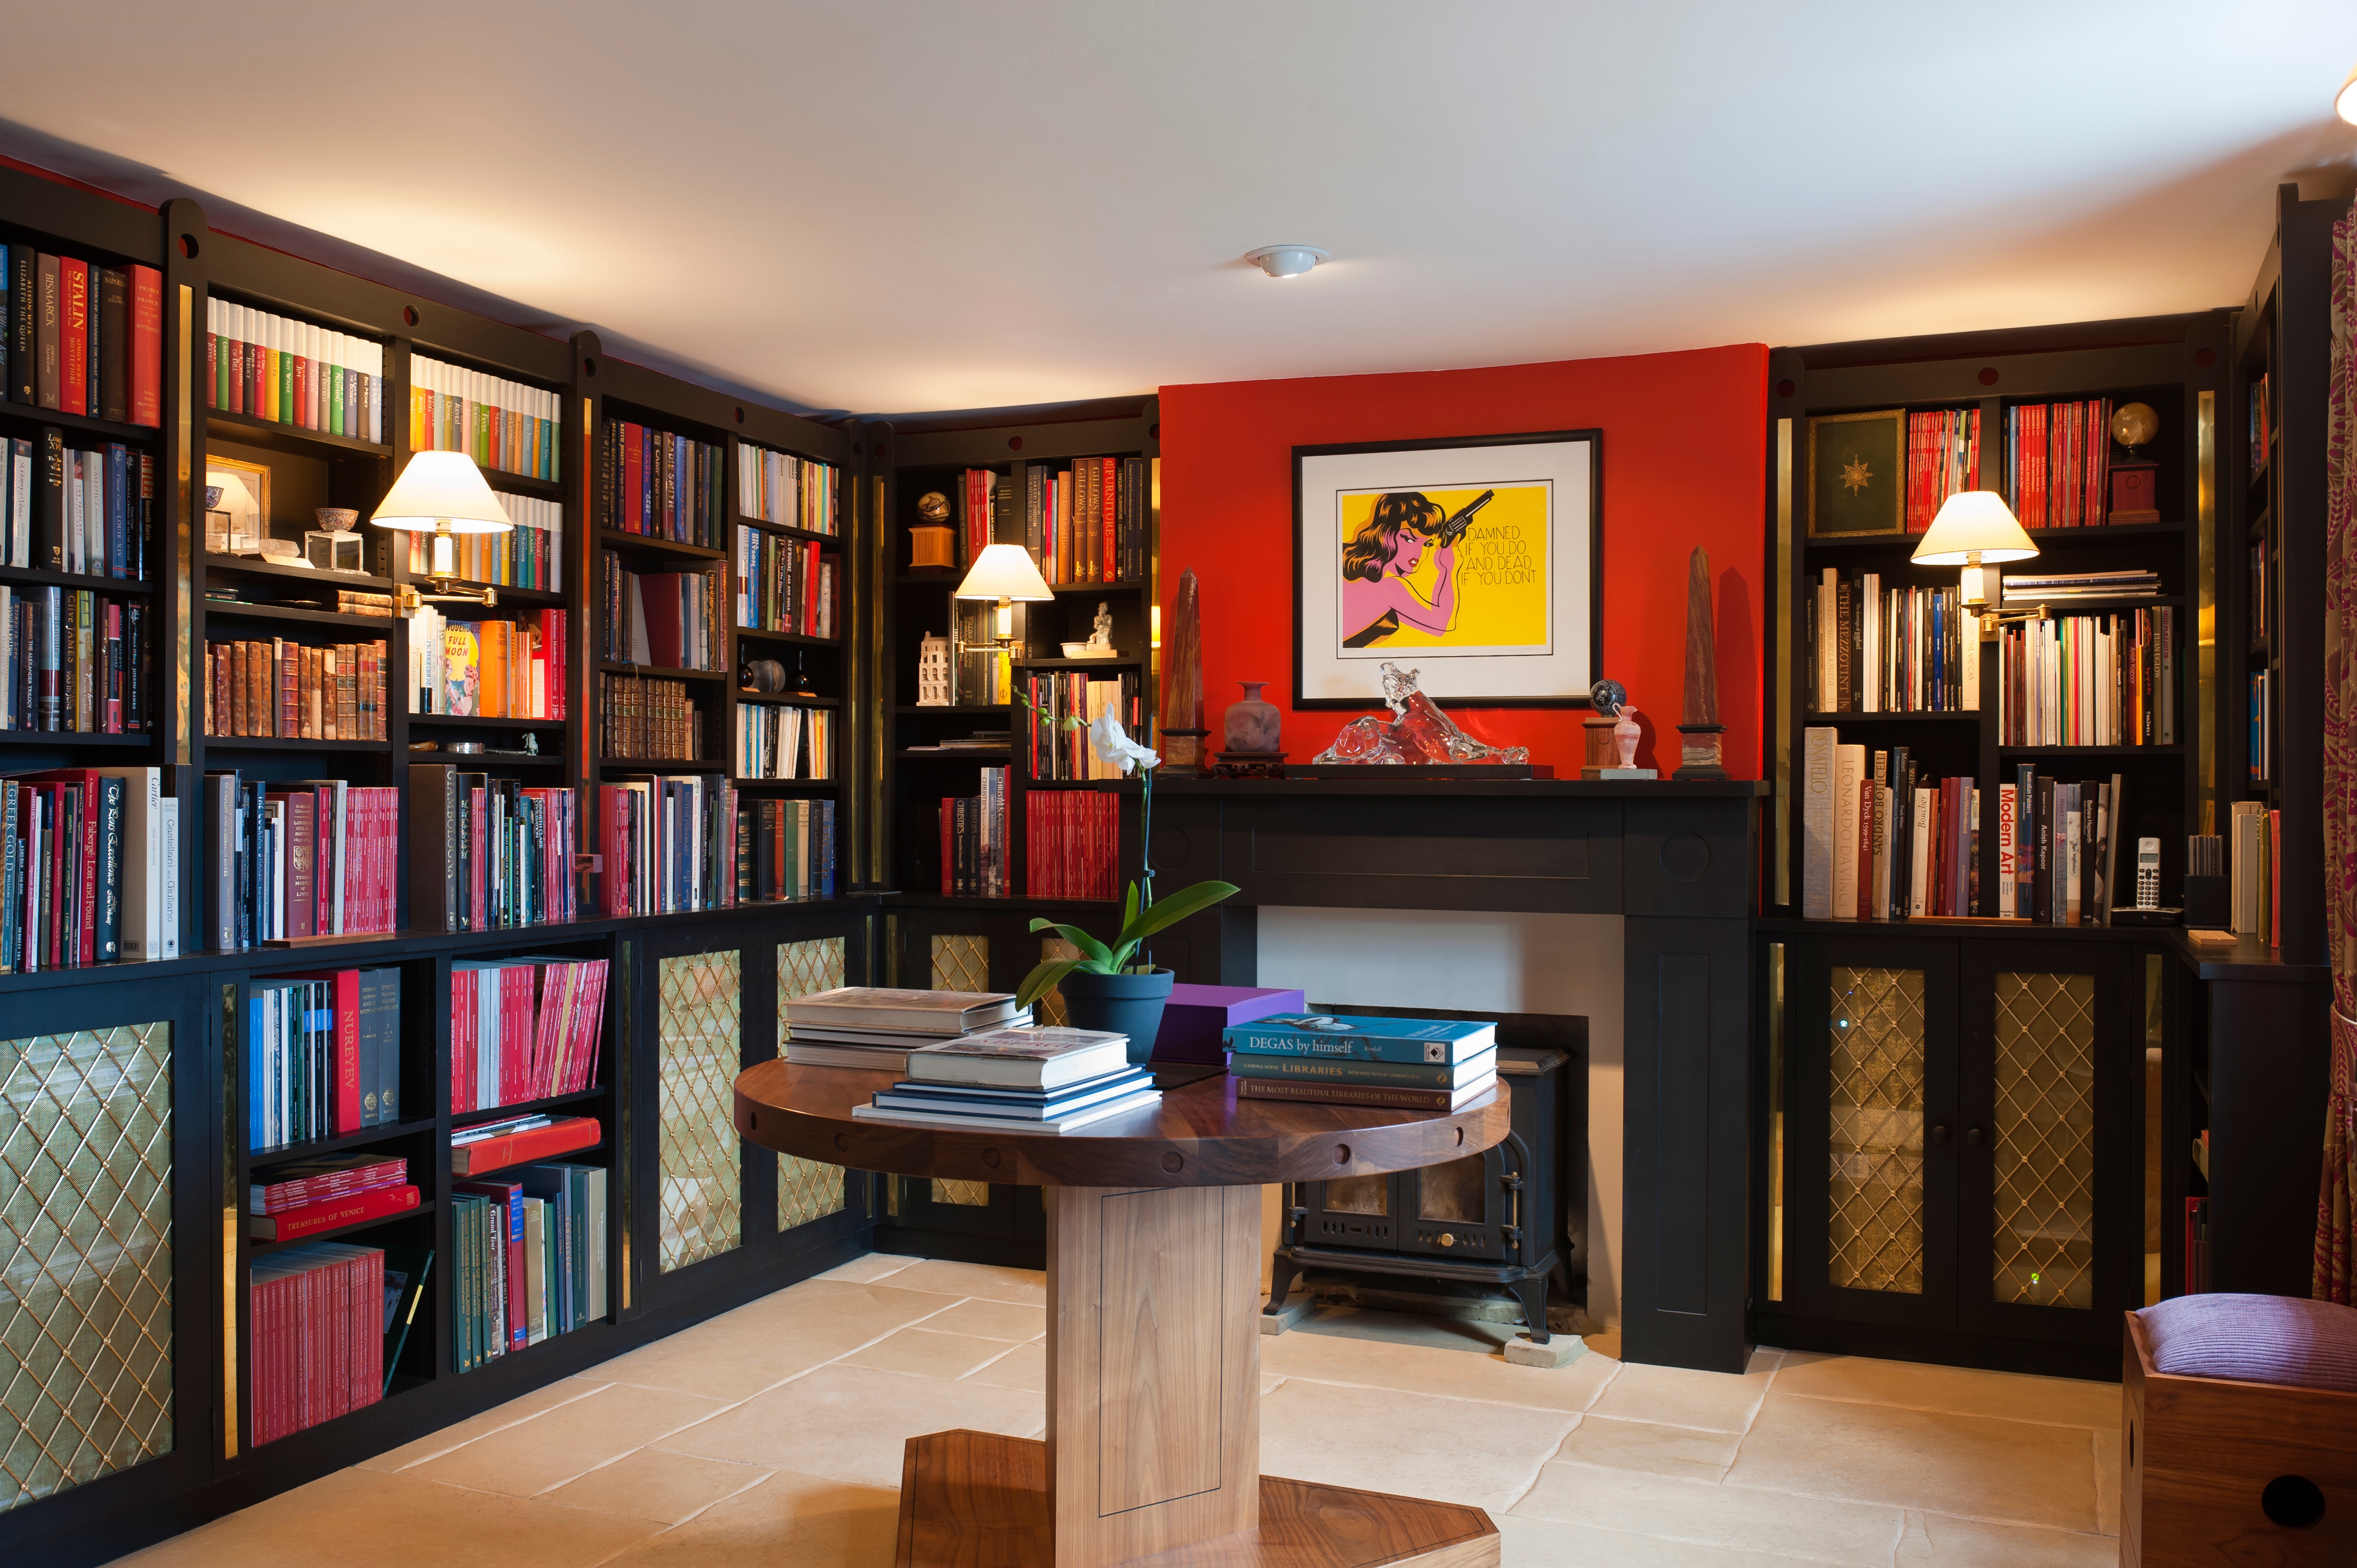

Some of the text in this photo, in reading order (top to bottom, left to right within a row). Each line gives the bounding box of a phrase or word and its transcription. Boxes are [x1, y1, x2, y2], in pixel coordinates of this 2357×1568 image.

[46, 273, 54, 328] BISMARCK
[73, 271, 84, 330] STALIN
[142, 456, 154, 499] ATTLEE
[1105, 470, 1114, 537] FURNITURE
[1465, 540, 1526, 556] IF YOU DO
[1468, 526, 1520, 541] DAMNED
[1461, 569, 1537, 586] IF YOU DON'T
[1466, 555, 1532, 571] AND DEAD
[66, 625, 76, 663] JAMES
[446, 647, 468, 657] MOON
[448, 636, 466, 645] FULL
[1839, 593, 1849, 693] THE MEZZOTINT
[1811, 732, 1828, 794] DONATELLO
[7, 788, 17, 833] GREEK
[151, 777, 160, 809] Cartier
[1863, 801, 1871, 820] Dyck
[1874, 753, 1886, 855] SANDRO BOTTICELLI
[1918, 795, 1928, 829] Boucher
[167, 819, 175, 867] Castellani
[447, 770, 457, 879] GIAMBOLOGNA
[1838, 760, 1854, 907] LEONARDO DA VINCI
[2000, 789, 2014, 875] Modern Art
[6, 834, 15, 872] GOLD
[87, 860, 95, 880] Lost
[822, 825, 830, 880] FRENCH
[85, 899, 94, 930] Found
[167, 880, 175, 922] Giuliano
[344, 1010, 355, 1089] NUREYEV
[1250, 1037, 1294, 1050] DEGAS
[1297, 1038, 1310, 1054] by
[1312, 1040, 1353, 1053] himself
[1282, 1063, 1342, 1076] LIBRARIES
[1291, 1088, 1330, 1096] BEAUTIFUL
[1332, 1090, 1369, 1099] LIBRARIES
[287, 1206, 365, 1231] TREASURES OF VENICE
